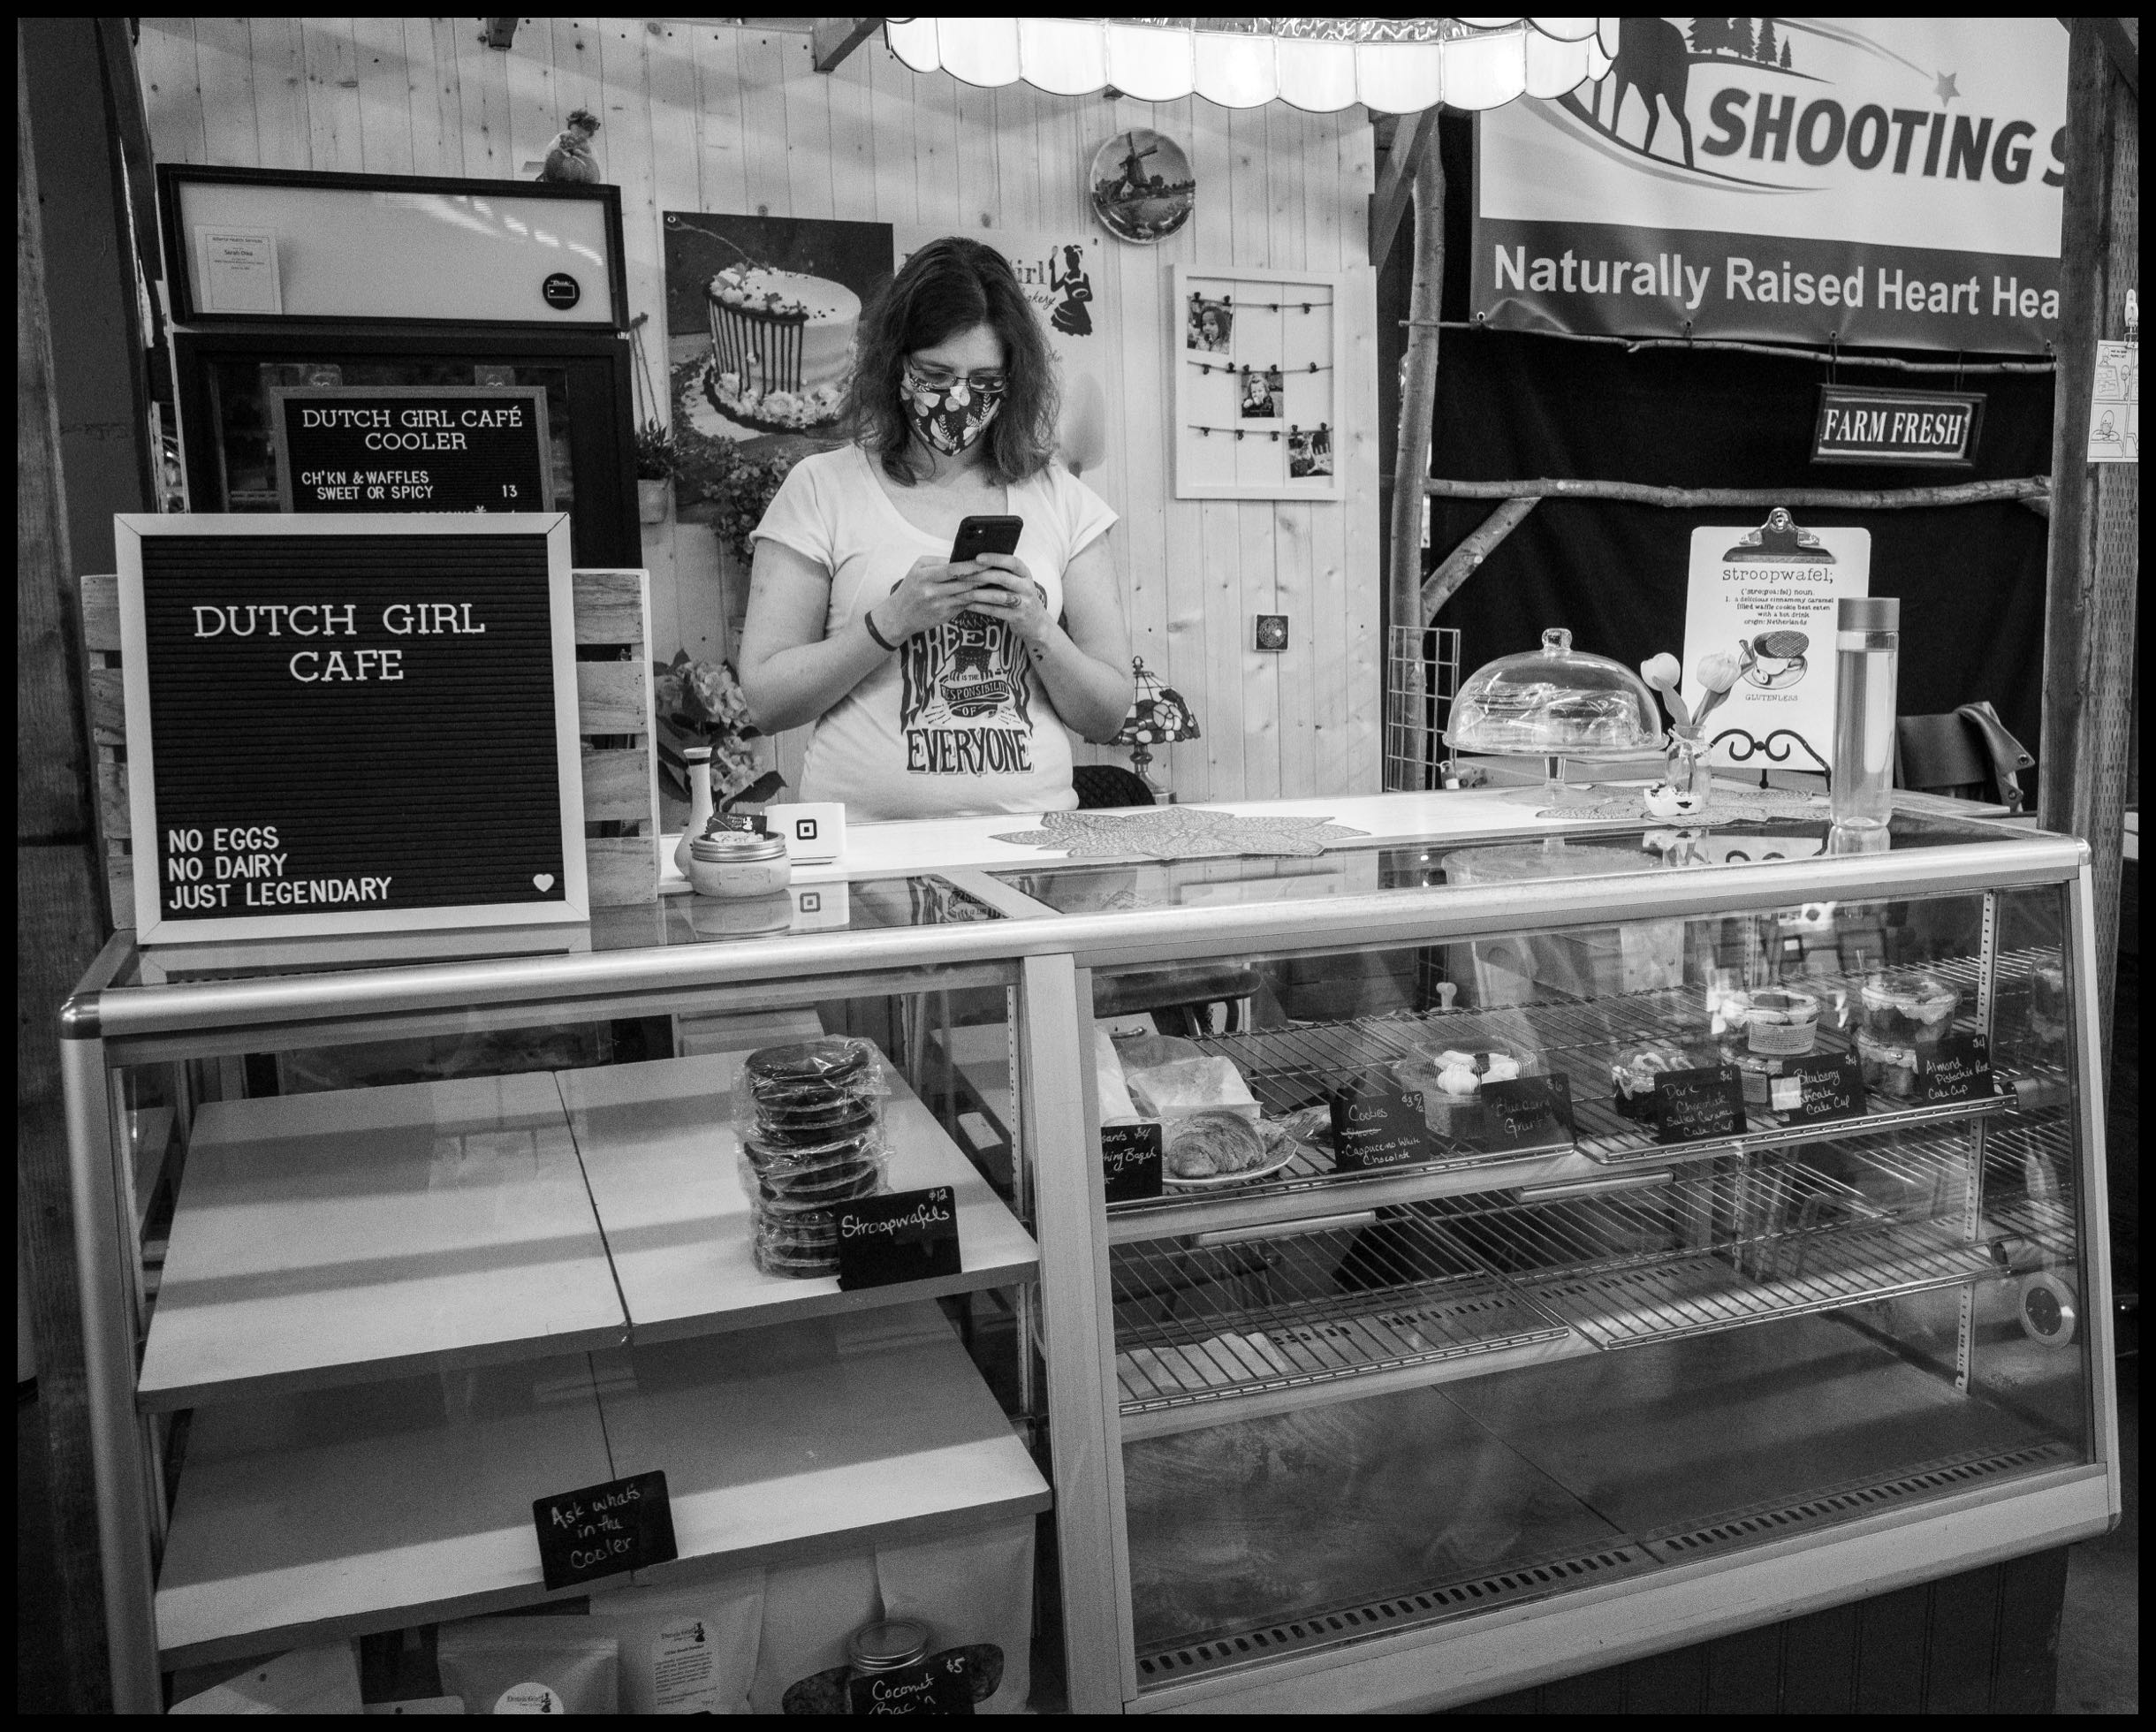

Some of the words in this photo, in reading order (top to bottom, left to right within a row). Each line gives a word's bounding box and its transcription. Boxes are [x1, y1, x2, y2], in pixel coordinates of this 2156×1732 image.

[1700, 87, 2037, 186] SHOOTING
[1009, 259, 1047, 285] irl
[1494, 244, 1711, 310] Naturally
[1726, 256, 1864, 308] Raised
[1877, 268, 1980, 316] Heart
[302, 409, 391, 428] DUTCH
[400, 409, 455, 429] GIRL
[461, 406, 522, 429] CAFÉ
[1824, 408, 1887, 443] FARM
[1890, 412, 1962, 444] FRESH
[365, 432, 467, 451] COOLER
[301, 470, 346, 485] CH'KN
[353, 472, 364, 484] &
[366, 470, 429, 485] WAFFLES
[316, 486, 360, 500] SWEET
[367, 486, 385, 500] OR
[391, 485, 433, 499] SPICY
[502, 484, 518, 498] 13
[1722, 567, 1833, 583] stroopwafel;
[192, 604, 357, 638] DUTCH
[382, 603, 485, 635] GIRL
[289, 649, 404, 683] CAFE
[941, 680, 1009, 702] RESPONSIBILITY
[961, 707, 976, 717] OF
[907, 727, 1034, 777] EVERYONE
[168, 829, 204, 853] NO
[213, 826, 279, 852] EGGS
[168, 857, 204, 882] NO
[215, 853, 288, 880] DAIRY
[170, 884, 232, 910] JUST
[246, 877, 392, 906] LEGENDARY
[1926, 1057, 1962, 1075] Almond
[1662, 1083, 1700, 1100] Dark
[1800, 1086, 1836, 1104] ancake
[1928, 1088, 1950, 1100] Cake
[1950, 1084, 1969, 1096] Cup
[1348, 1104, 1388, 1121] Cookies
[1806, 1101, 1833, 1115] Cake
[1833, 1095, 1850, 1108] Cup
[1102, 1130, 1127, 1143] sants
[841, 1203, 951, 1238] Stroopwafels
[551, 1502, 585, 1529] Ask
[577, 1524, 596, 1538] in
[597, 1514, 624, 1531] the
[570, 1538, 632, 1569] Cooler
[946, 1656, 966, 1674] $5
[871, 1672, 935, 1701] Coconut
